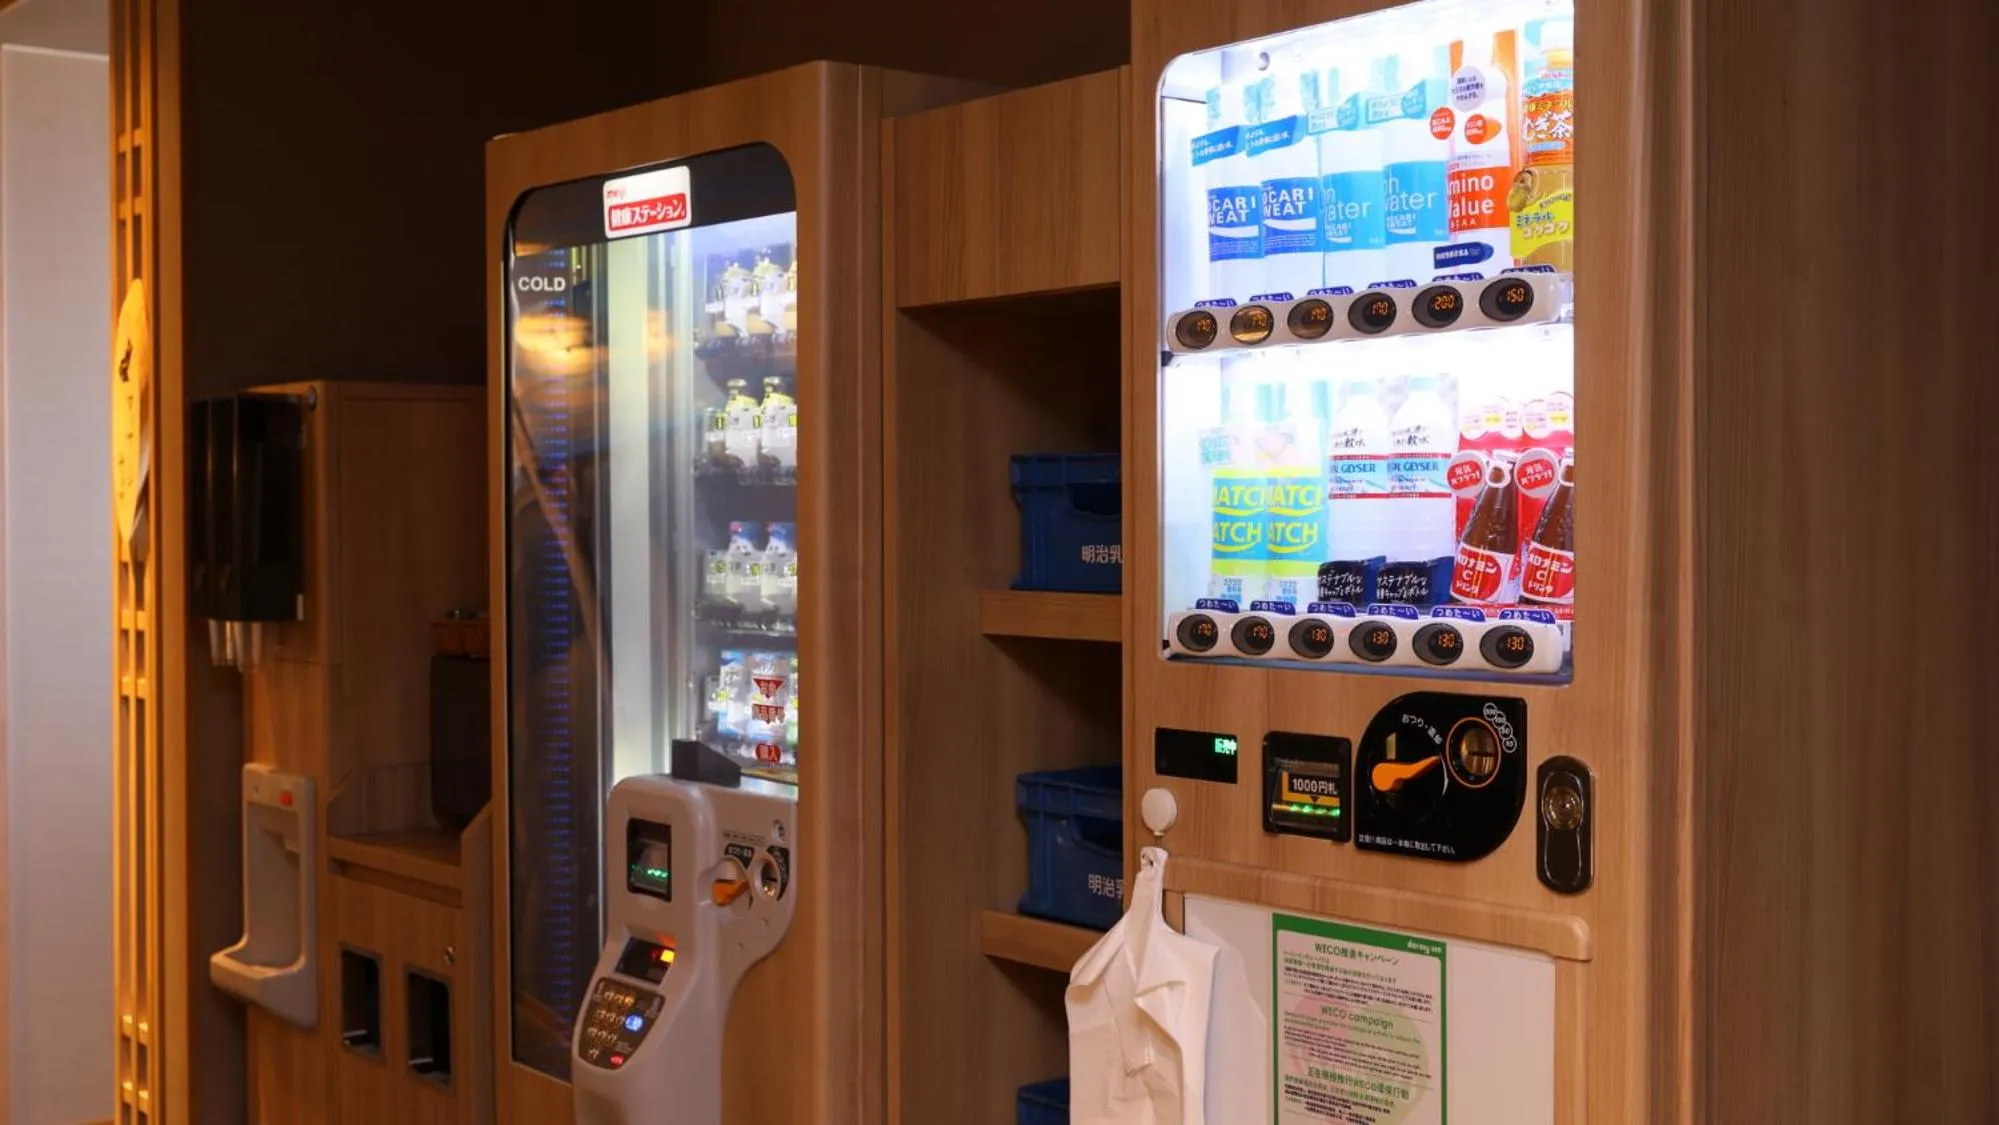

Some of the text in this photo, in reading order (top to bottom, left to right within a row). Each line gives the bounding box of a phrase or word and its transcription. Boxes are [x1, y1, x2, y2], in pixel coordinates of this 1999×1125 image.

[518, 276, 566, 292] COLD
[1434, 295, 1455, 310] 200
[1506, 288, 1524, 302] 150
[1373, 631, 1388, 644] 130
[1507, 636, 1524, 650] 130
[1292, 778, 1338, 795] 1000円札
[1349, 1011, 1394, 1029] campaign
